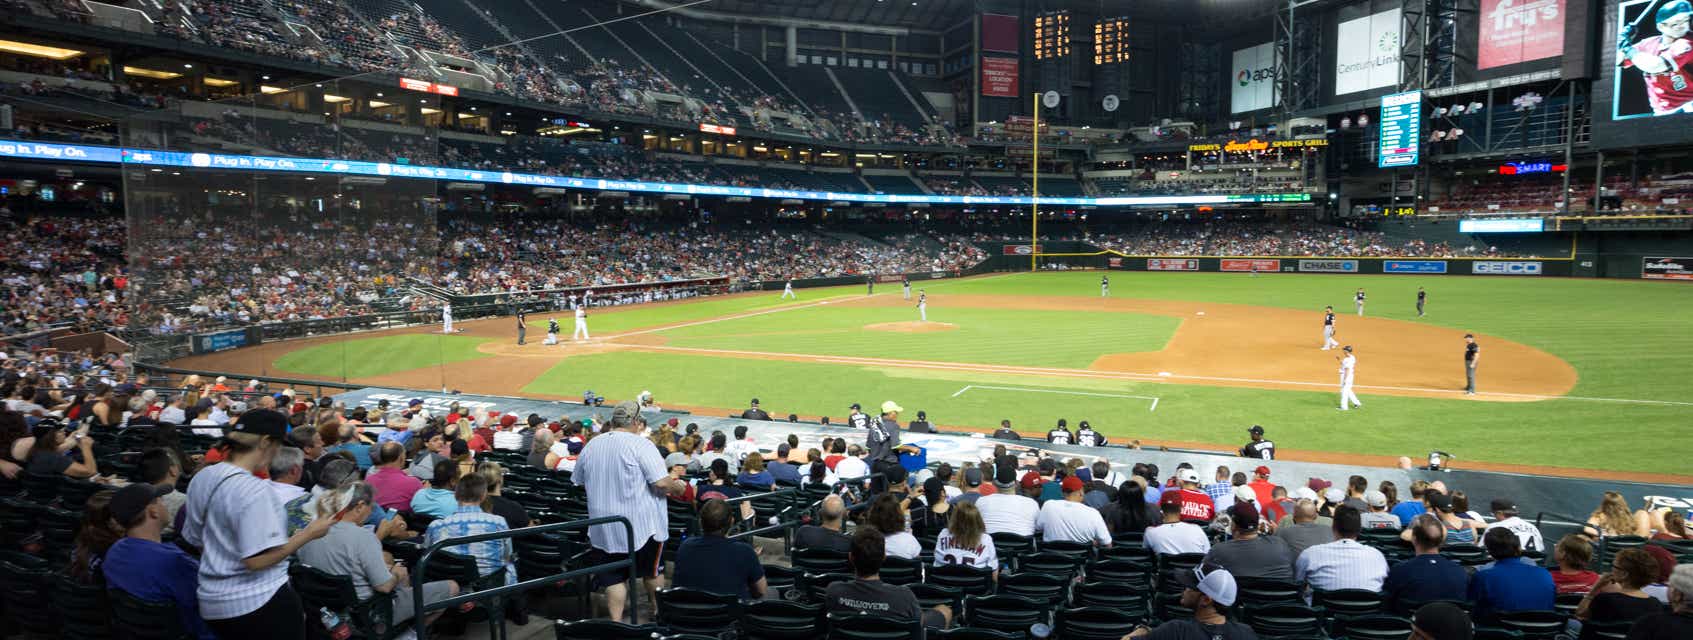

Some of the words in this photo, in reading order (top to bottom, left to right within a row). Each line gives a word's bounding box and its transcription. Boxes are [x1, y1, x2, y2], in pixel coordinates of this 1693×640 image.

[1338, 53, 1402, 75] CenturyLink
[1252, 66, 1275, 83] aps
[1271, 140, 1304, 148] SPORTS
[1304, 139, 1329, 147] GRILL
[34, 145, 63, 157] Play
[1304, 261, 1341, 270] CHASE
[1477, 263, 1538, 273] GEICO
[1079, 435, 1095, 447] 36
[1262, 449, 1271, 460] 8
